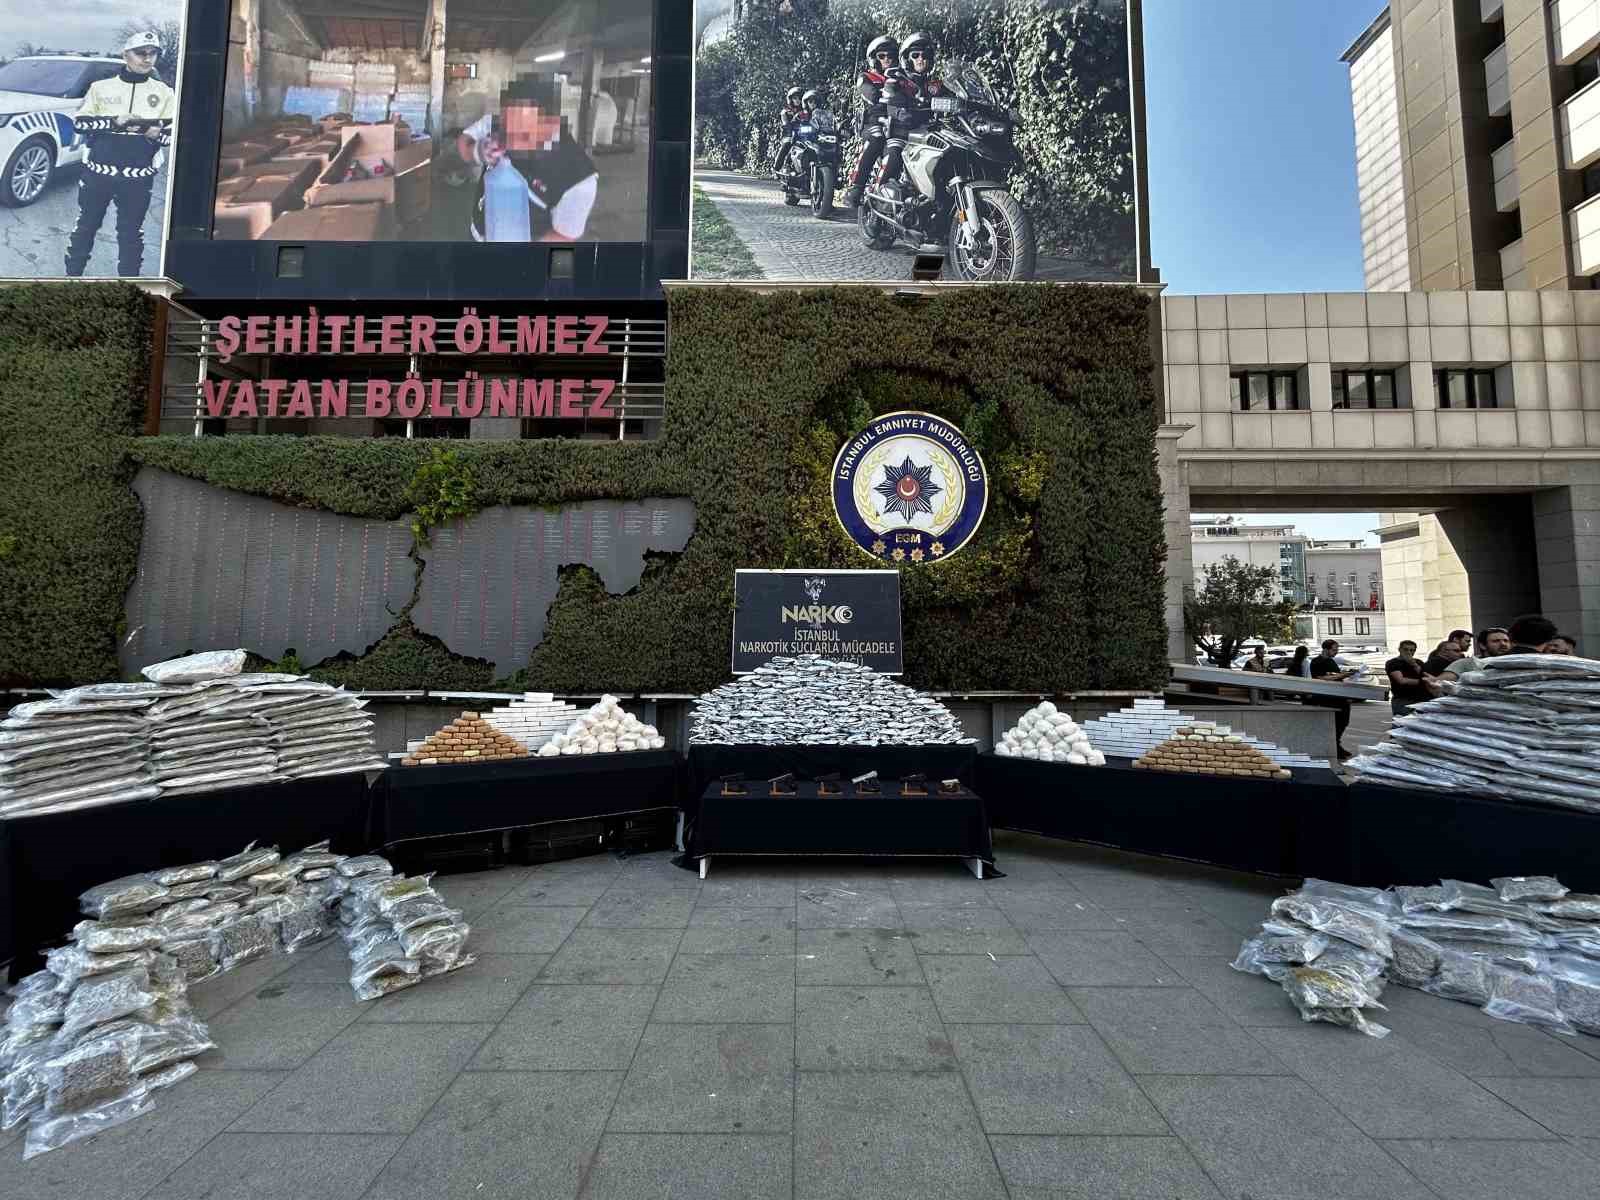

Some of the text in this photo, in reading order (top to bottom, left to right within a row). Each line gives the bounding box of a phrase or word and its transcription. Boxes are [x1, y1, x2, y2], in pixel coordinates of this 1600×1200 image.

[215, 306, 610, 363] ŞEHİTLER ÖLMEZ
[203, 370, 616, 418] VATAN BÖLÜNMEZ
[895, 533, 921, 544] EGM
[794, 627, 840, 641] İSTANBUL
[740, 639, 788, 653] NARKOTİK
[842, 640, 895, 654] MÜCADELE
